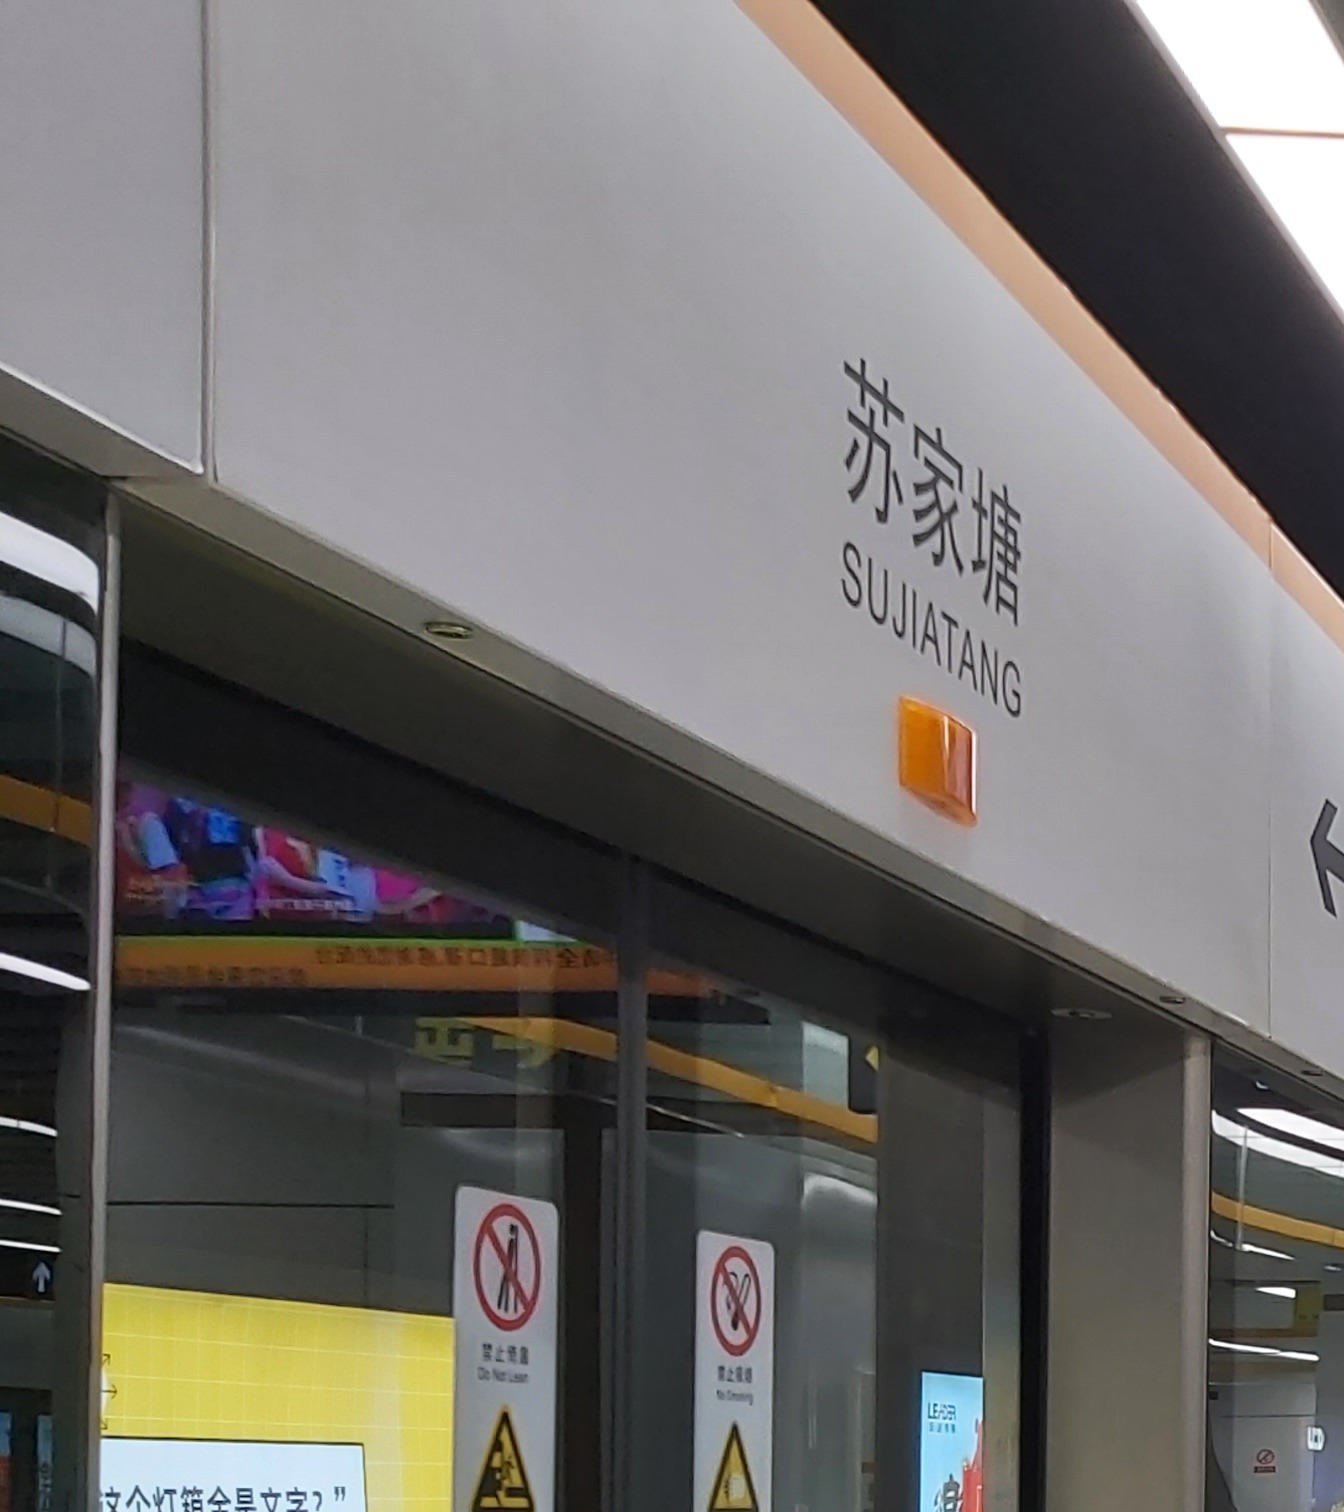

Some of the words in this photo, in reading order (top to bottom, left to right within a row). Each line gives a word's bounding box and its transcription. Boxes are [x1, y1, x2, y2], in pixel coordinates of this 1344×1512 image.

[843, 358, 1022, 627] 苏家塘
[841, 541, 1022, 718] SUJIATANG
